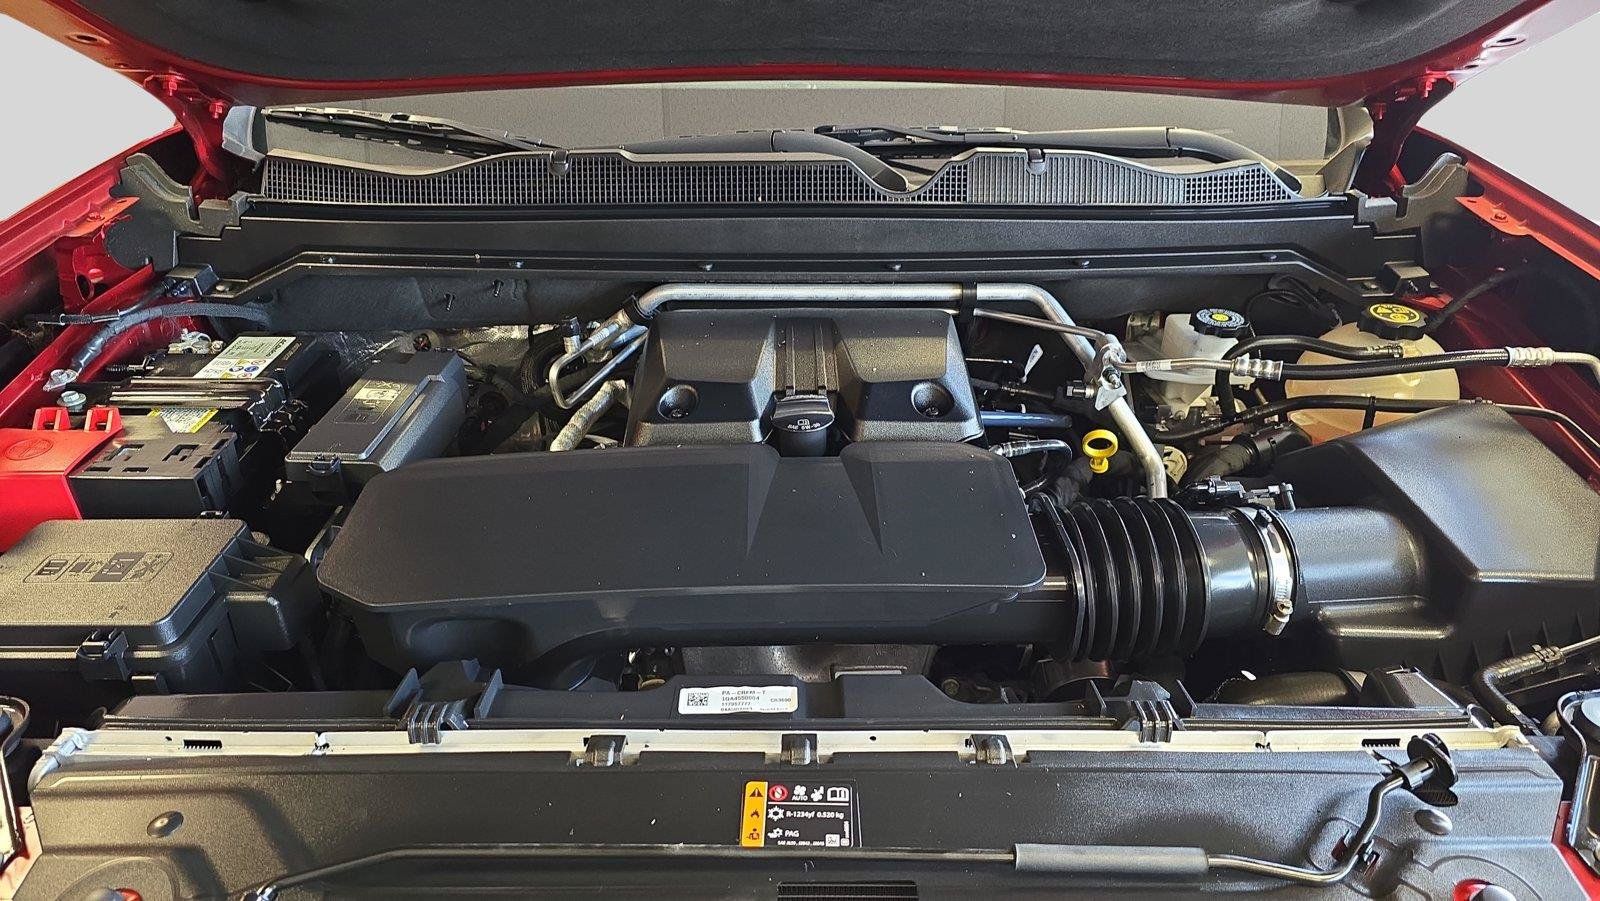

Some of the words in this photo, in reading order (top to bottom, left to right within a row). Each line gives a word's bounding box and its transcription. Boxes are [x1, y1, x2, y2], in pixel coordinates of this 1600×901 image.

[786, 810, 815, 819] R-1234yf
[817, 811, 835, 819] 0.520
[835, 811, 845, 820] kg
[785, 830, 800, 838] PAG
